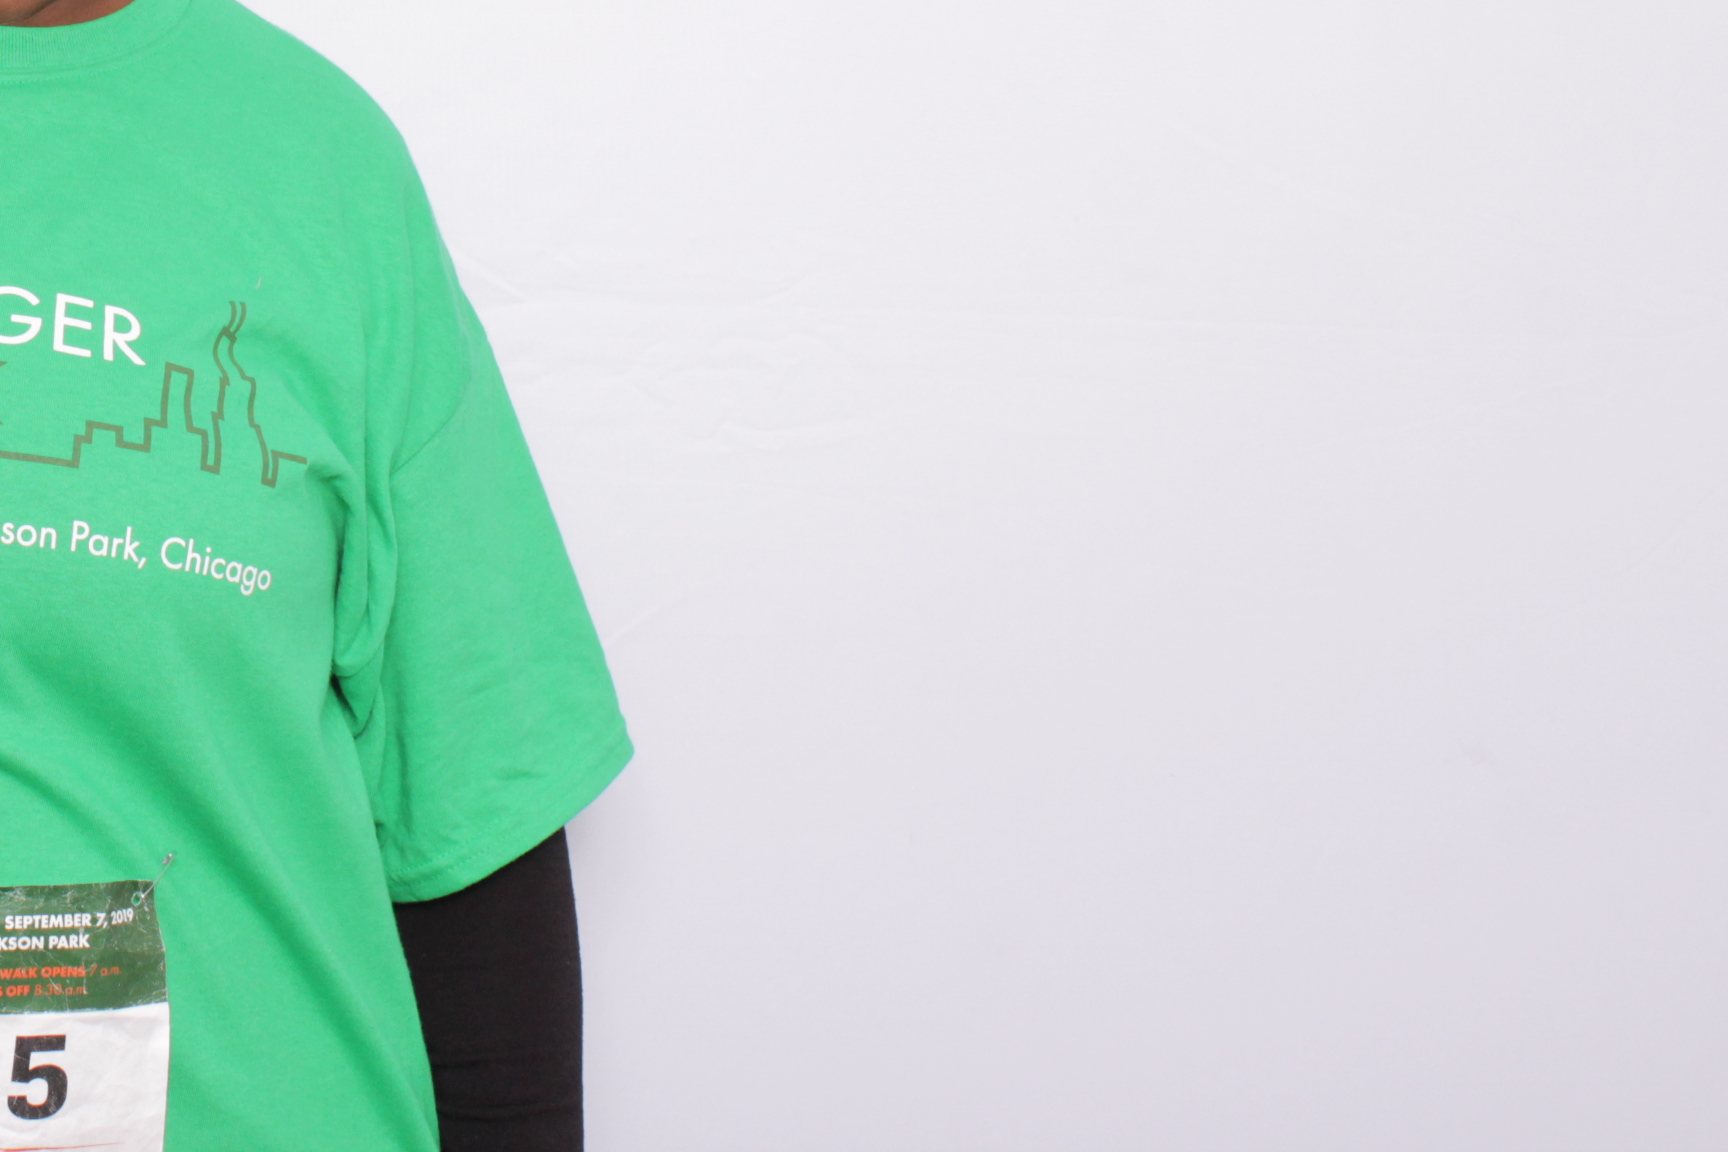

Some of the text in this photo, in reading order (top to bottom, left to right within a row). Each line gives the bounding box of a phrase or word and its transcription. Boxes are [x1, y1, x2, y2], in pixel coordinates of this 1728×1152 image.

[70, 520, 146, 569] Park,
[160, 536, 272, 596] Chicago
[4, 913, 91, 931] SEPTEMBER
[95, 912, 108, 930] 7,
[110, 907, 134, 926] 2019
[48, 933, 90, 949] PARK
[0, 966, 38, 979] WALK
[41, 965, 86, 978] OPENS
[6, 985, 31, 997] OFF
